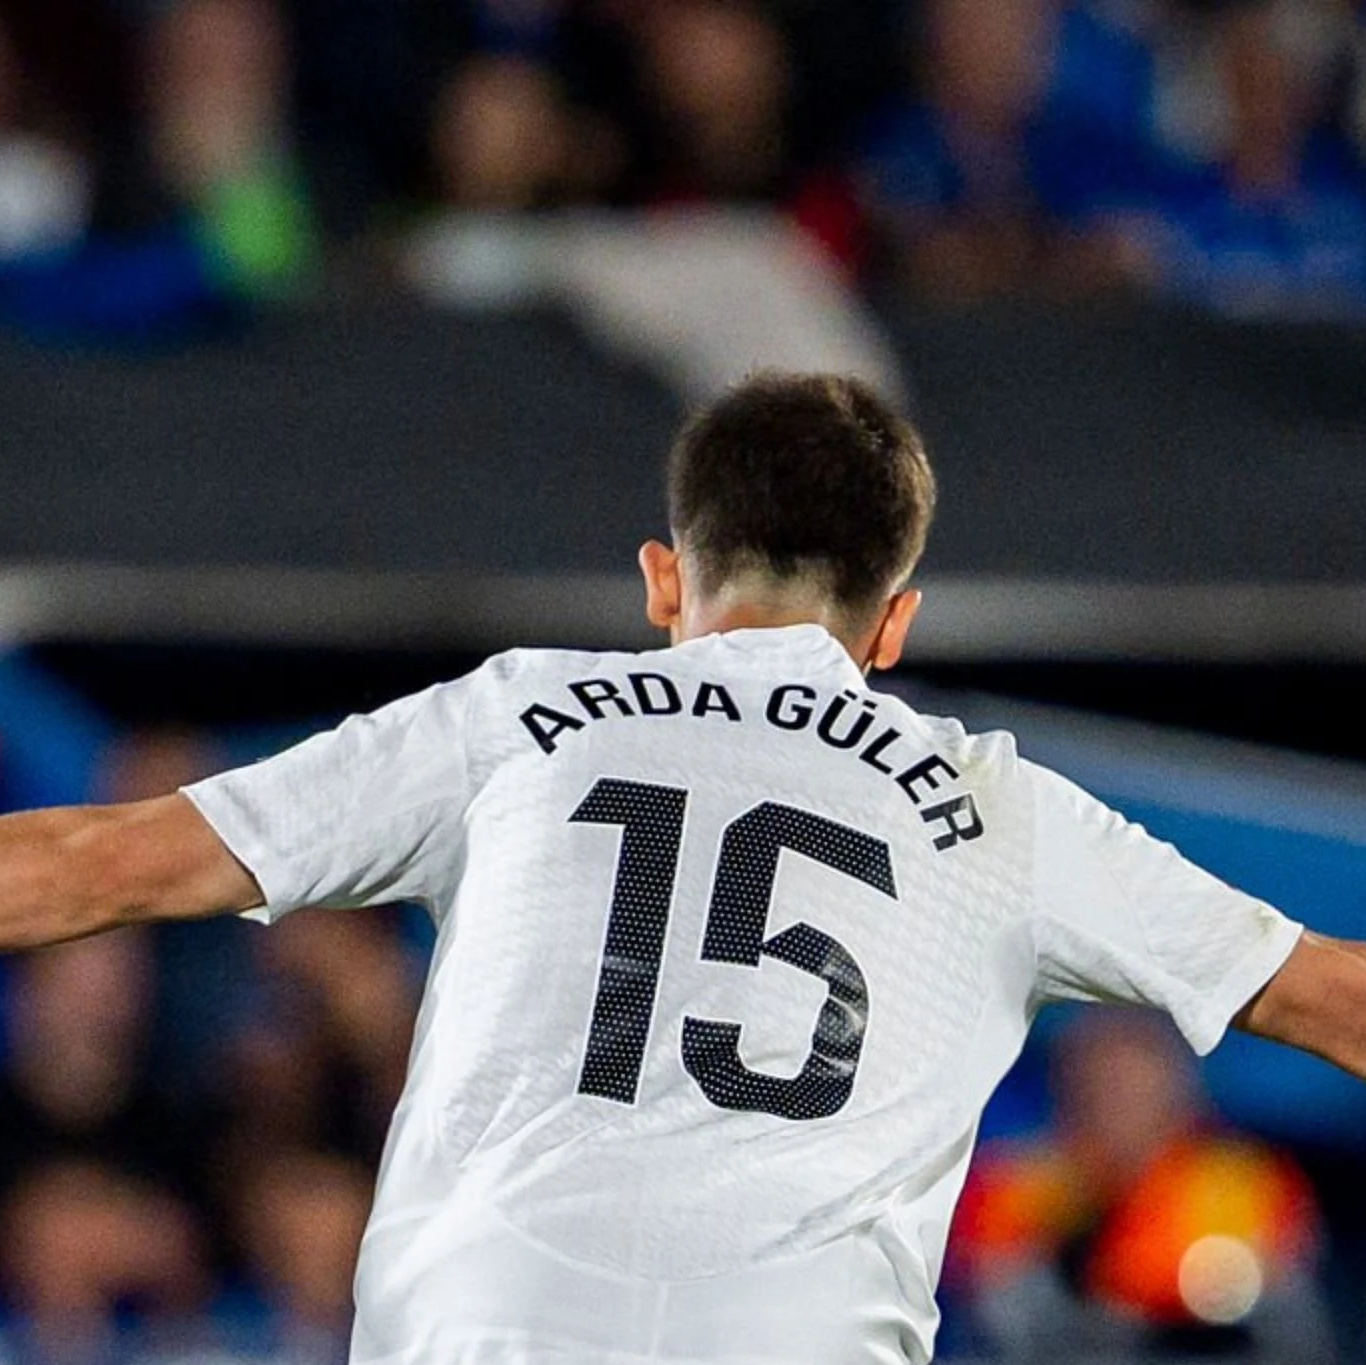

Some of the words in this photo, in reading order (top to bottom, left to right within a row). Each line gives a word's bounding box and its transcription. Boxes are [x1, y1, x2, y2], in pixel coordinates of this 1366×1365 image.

[519, 672, 741, 754] ARDA
[766, 685, 985, 852] GÜLER
[567, 777, 899, 1121] 15
